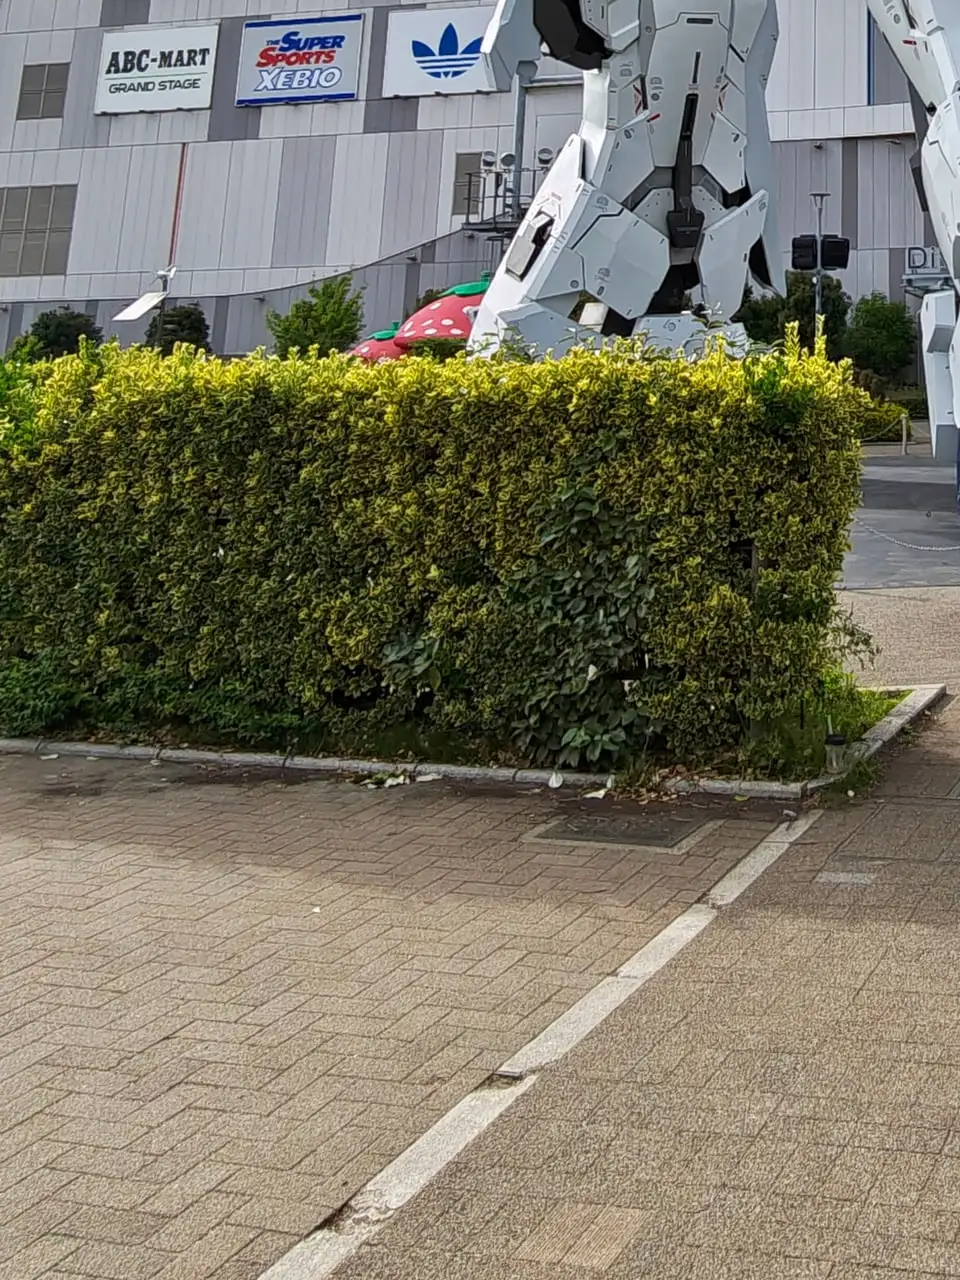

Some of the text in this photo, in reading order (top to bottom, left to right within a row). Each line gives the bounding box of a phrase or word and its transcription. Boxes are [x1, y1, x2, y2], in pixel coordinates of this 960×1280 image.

[278, 31, 345, 52] SUPER
[105, 48, 210, 75] ABC-MART
[256, 47, 337, 68] SPORTS
[109, 78, 201, 94] GRAND STAGE
[253, 66, 343, 93] XEBIO
